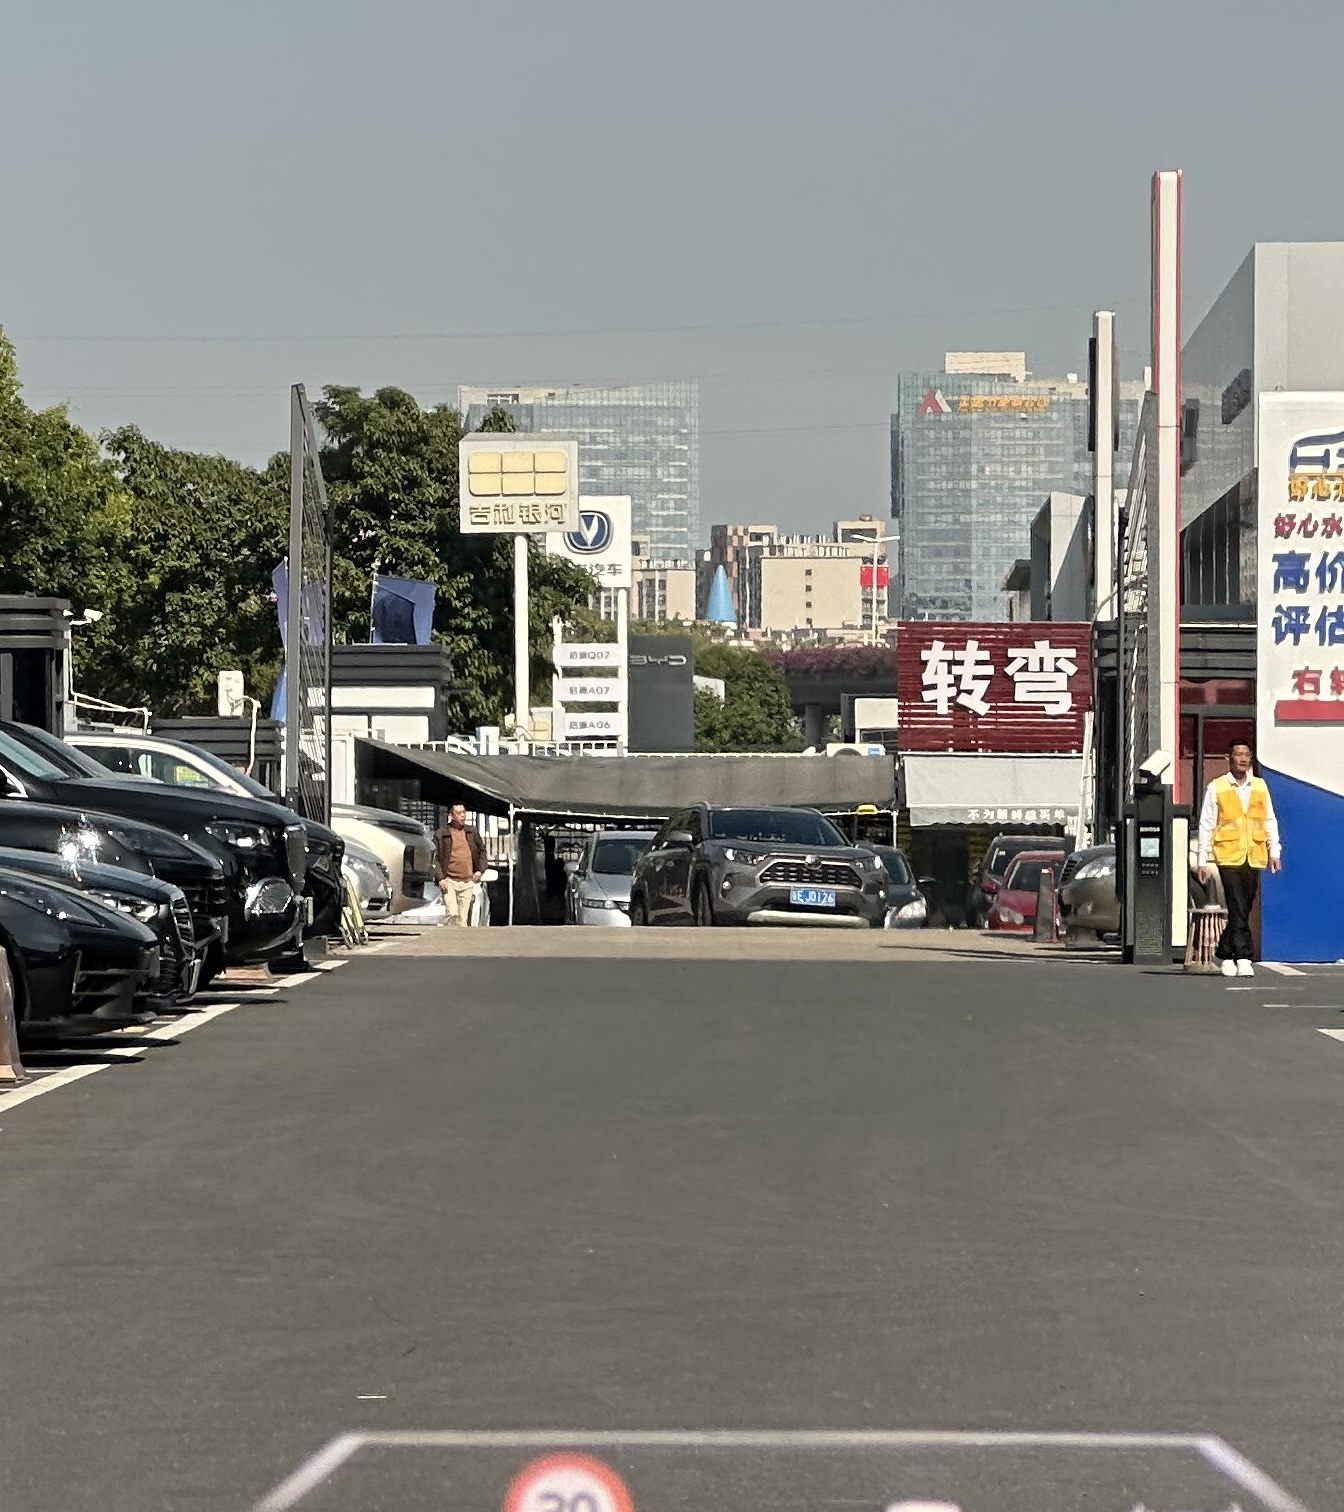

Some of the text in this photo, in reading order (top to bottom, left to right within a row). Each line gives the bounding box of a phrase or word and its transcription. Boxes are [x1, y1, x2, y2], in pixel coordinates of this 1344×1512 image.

[469, 503, 567, 525] 吉利银河
[577, 563, 623, 577] 汽车
[629, 654, 687, 666] BYD
[921, 640, 1078, 716] 转弯
